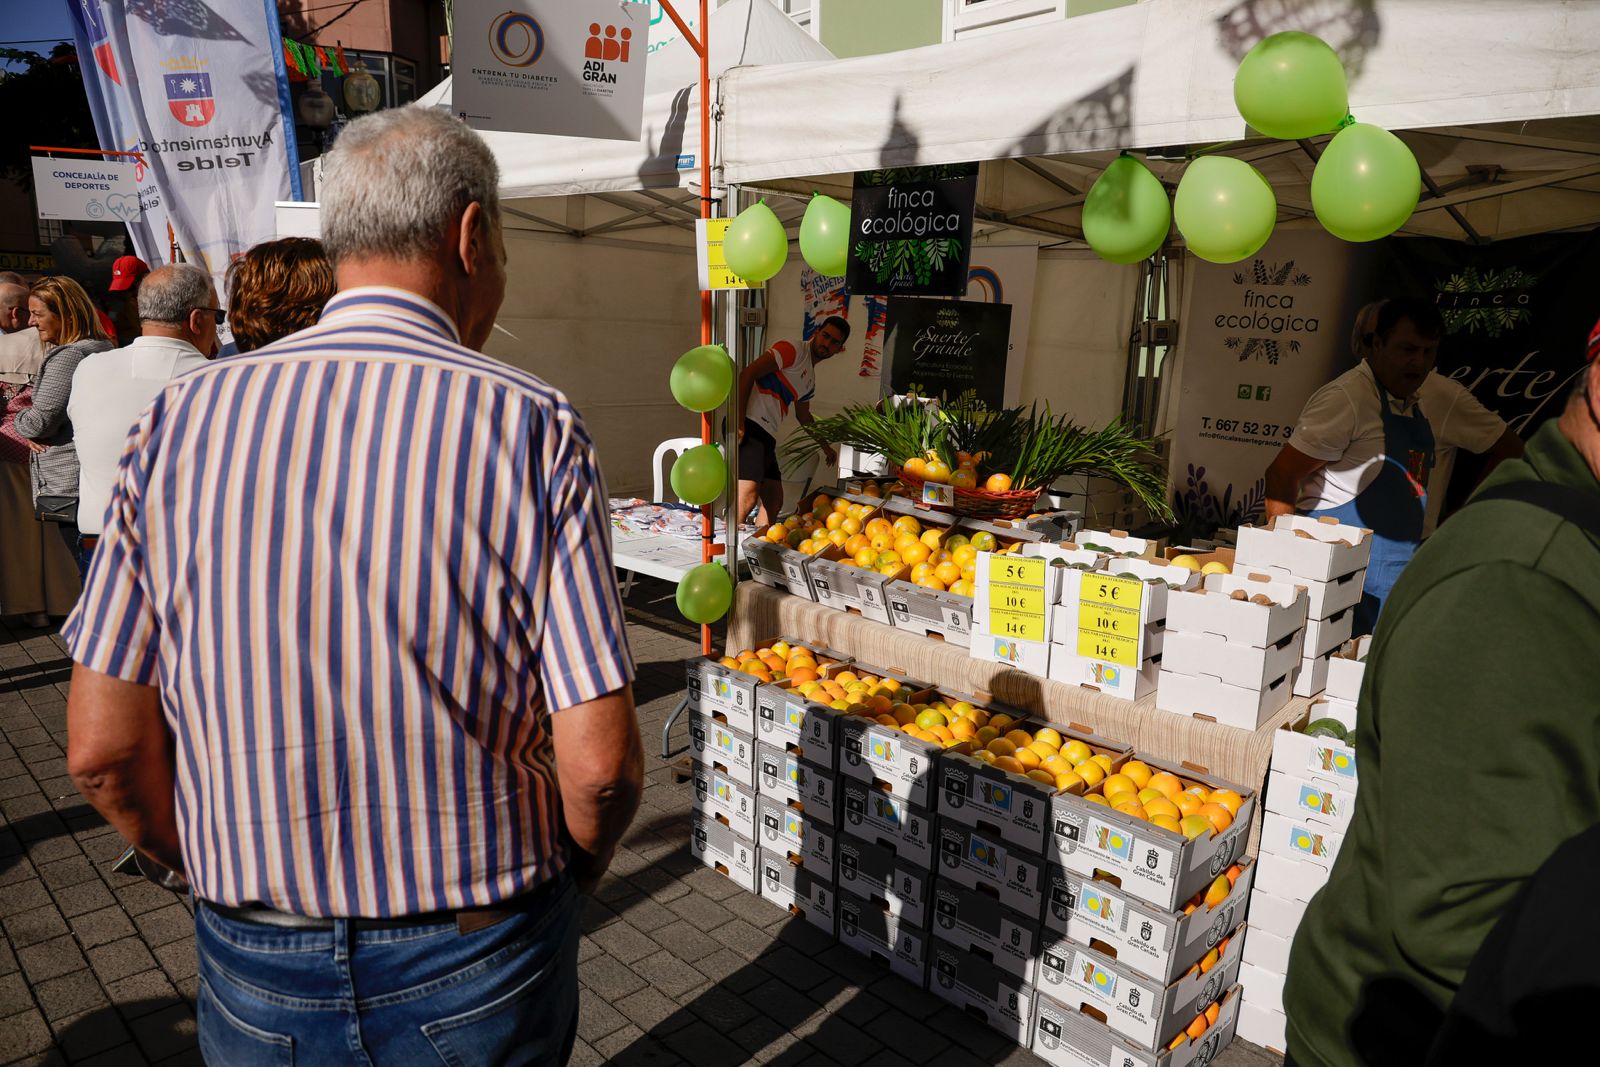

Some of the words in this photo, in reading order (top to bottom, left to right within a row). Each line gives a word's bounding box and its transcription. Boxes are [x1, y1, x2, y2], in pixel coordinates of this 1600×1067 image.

[584, 61, 604, 72] ADI
[472, 68, 507, 78] ENTRENA
[522, 74, 558, 83] DIABETES
[582, 71, 617, 84] GRAN
[52, 170, 106, 181] CONCEJALÍA
[65, 182, 110, 191] DEPORTES
[888, 186, 935, 208] finca
[861, 210, 960, 236] ecológica
[725, 276, 736, 284] 14
[1244, 289, 1294, 309] finca
[1436, 293, 1530, 306] finca
[1214, 310, 1319, 334] ecológica
[926, 326, 968, 344] Suerte
[912, 332, 980, 361] Grande
[1202, 416, 1211, 430] T.
[1216, 418, 1240, 432] 667
[1242, 422, 1259, 435] 52
[1262, 424, 1279, 437] 37
[1282, 426, 1295, 439] 3
[1006, 565, 1014, 578] 5
[1017, 566, 1026, 579] €
[1099, 584, 1107, 598] 5
[1111, 587, 1120, 600] €
[1006, 596, 1017, 608] 10
[1020, 598, 1026, 608] €
[1006, 622, 1017, 633] 14
[1020, 624, 1026, 634] €
[1097, 617, 1108, 628] 10
[1112, 620, 1119, 630] €
[1096, 644, 1107, 656] 14
[1111, 648, 1118, 658] €
[1133, 869, 1145, 878] Gran
[1146, 874, 1166, 886] Canaria
[1136, 865, 1155, 877] Cabildo
[1074, 911, 1101, 927] Ayuntamiento
[1130, 936, 1149, 948] Cabildo
[1127, 940, 1140, 949] Gran
[1140, 946, 1160, 959] Canaria
[1116, 1006, 1128, 1015] Gran
[1128, 1012, 1147, 1025] Canaria
[1119, 1002, 1137, 1015] Cabildo
